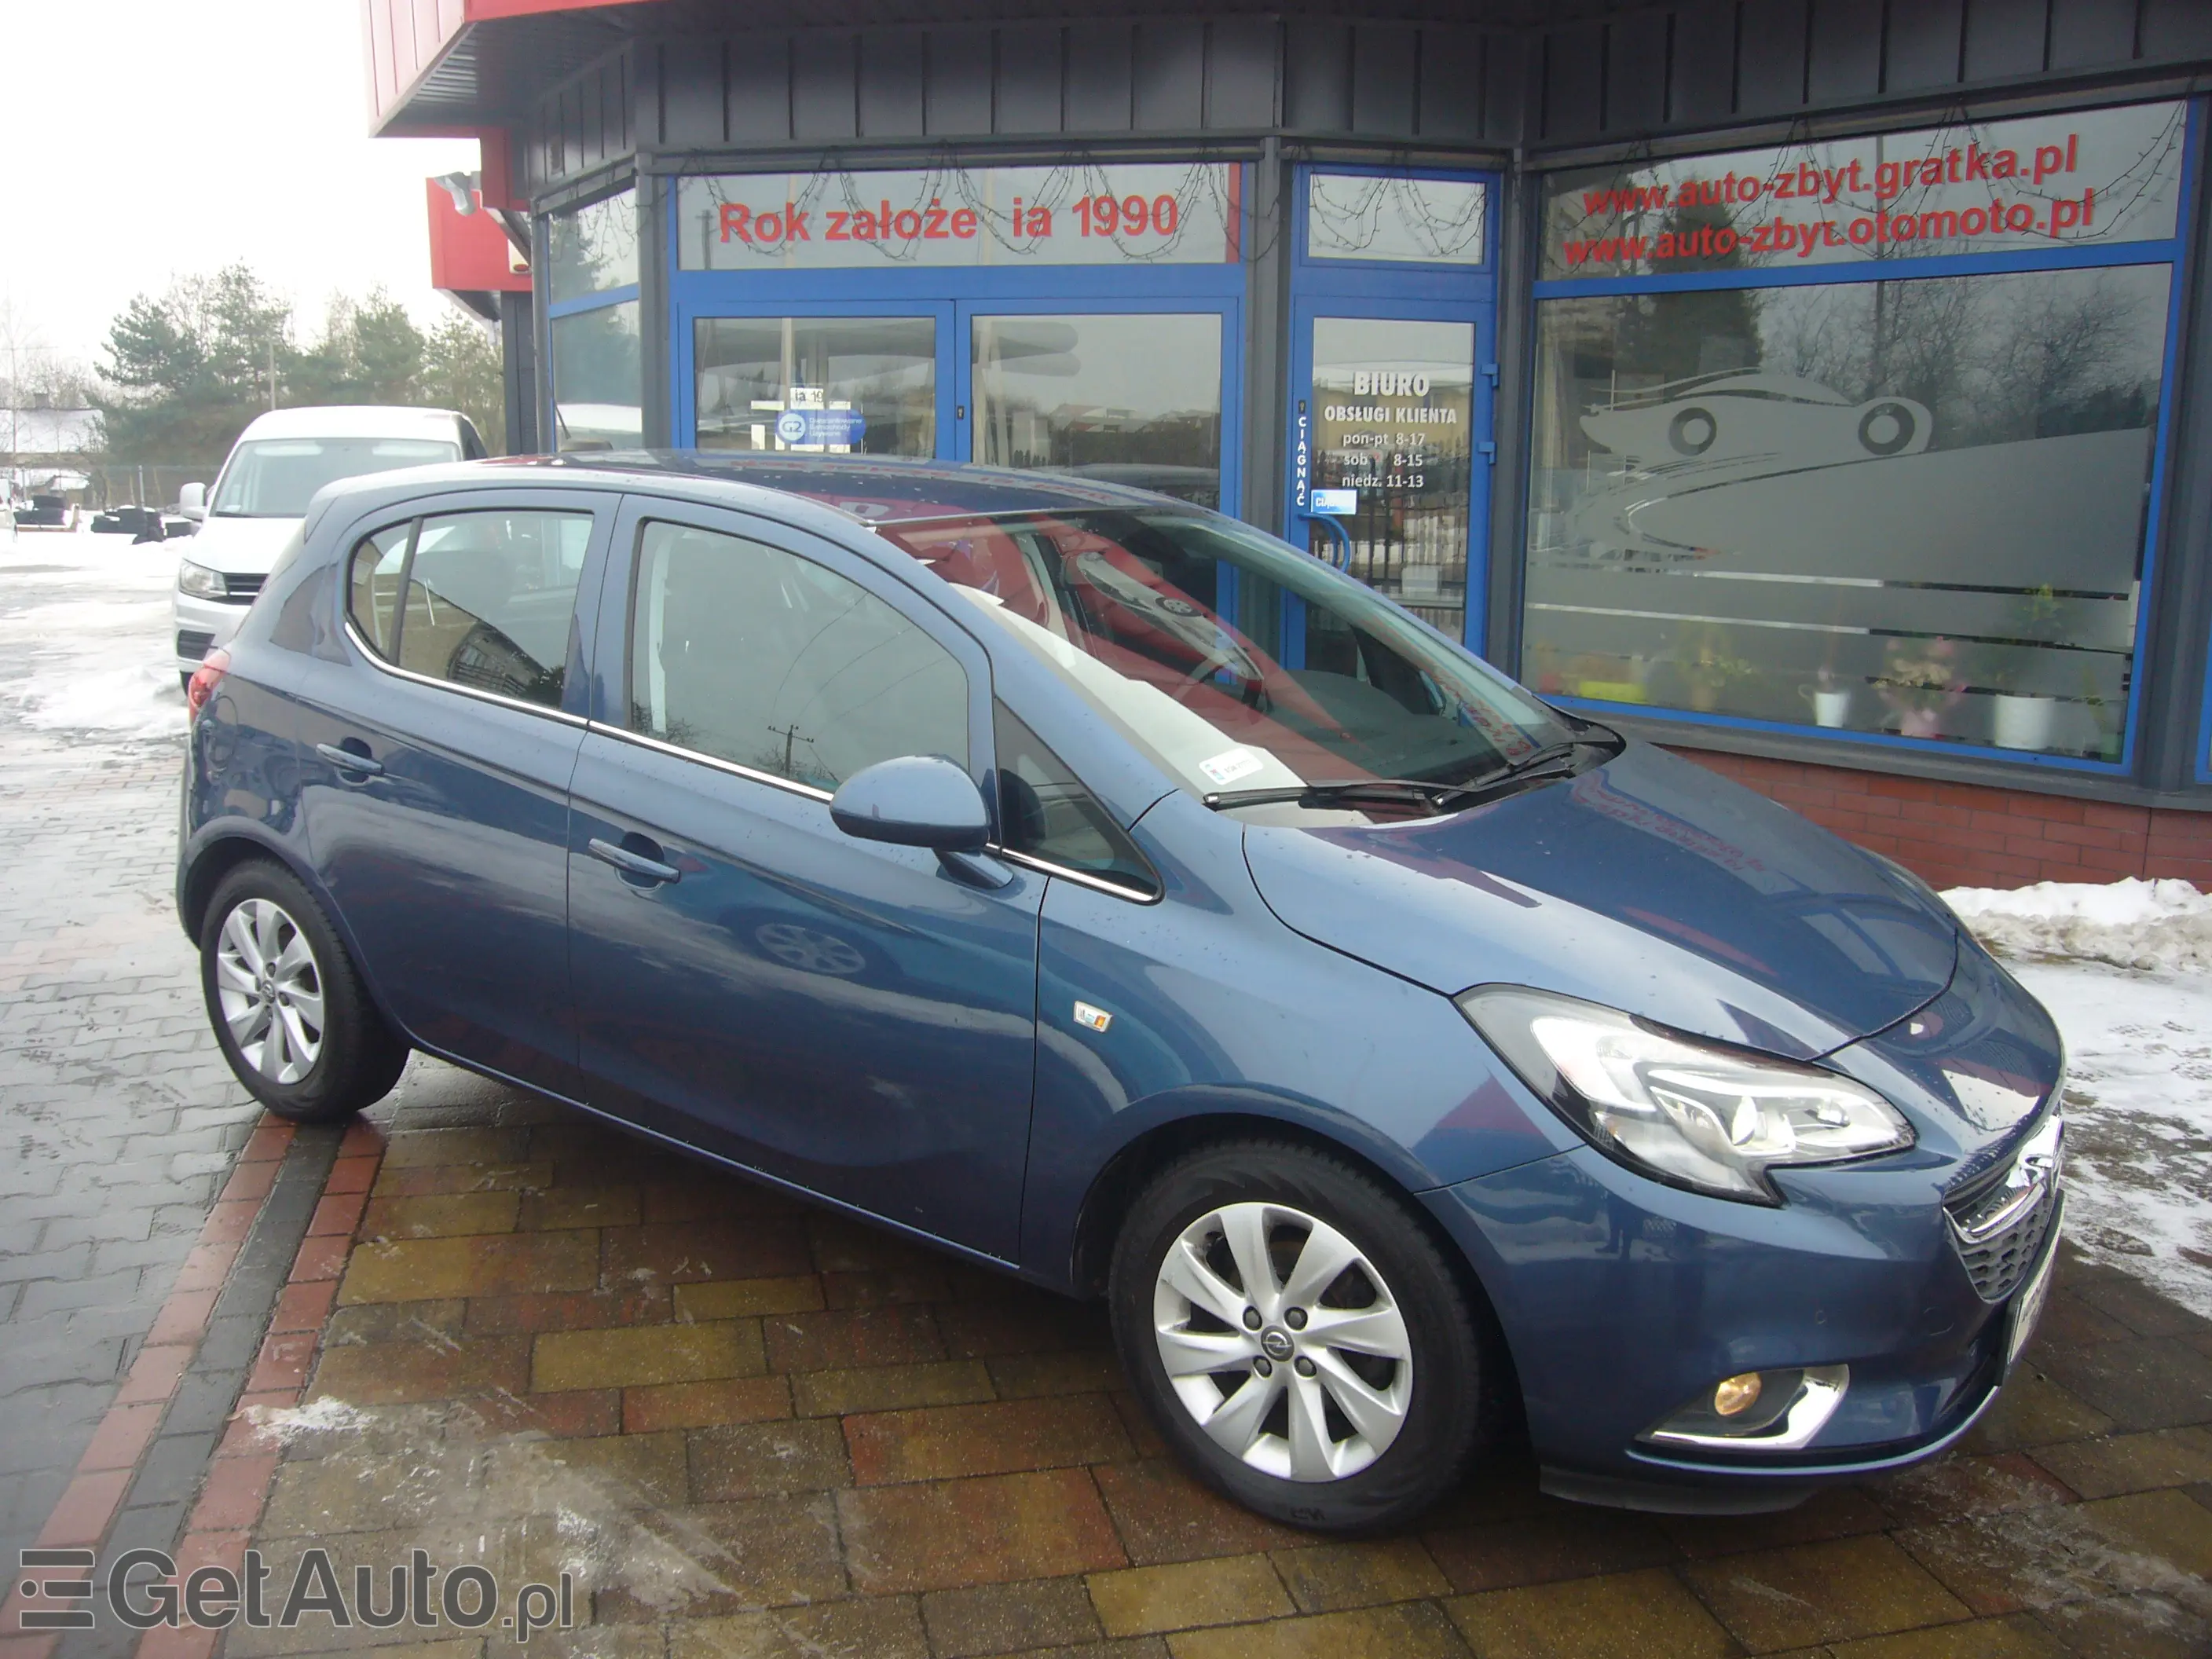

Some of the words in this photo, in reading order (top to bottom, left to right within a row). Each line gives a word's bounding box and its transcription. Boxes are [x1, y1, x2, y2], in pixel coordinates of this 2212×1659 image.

[1583, 132, 2079, 218] www.auto-zbyt.gratka.pl
[719, 201, 811, 243] Rok
[825, 198, 978, 240] założe
[1012, 196, 1053, 238] ia
[1071, 194, 1179, 237] 1990
[1562, 187, 2095, 266] www.auto-zbyt.otomoto.pl
[1353, 372, 1430, 397] BIURO
[1324, 405, 1390, 423] OBSŁUGI
[1395, 407, 1457, 424] KLIENTA
[1342, 432, 1389, 447] pon-pt
[1395, 432, 1426, 446] 8-17
[1343, 452, 1368, 467] sob
[1393, 453, 1424, 467] 8-15
[1342, 473, 1382, 488] niedz.
[1386, 474, 1425, 489] 11-13
